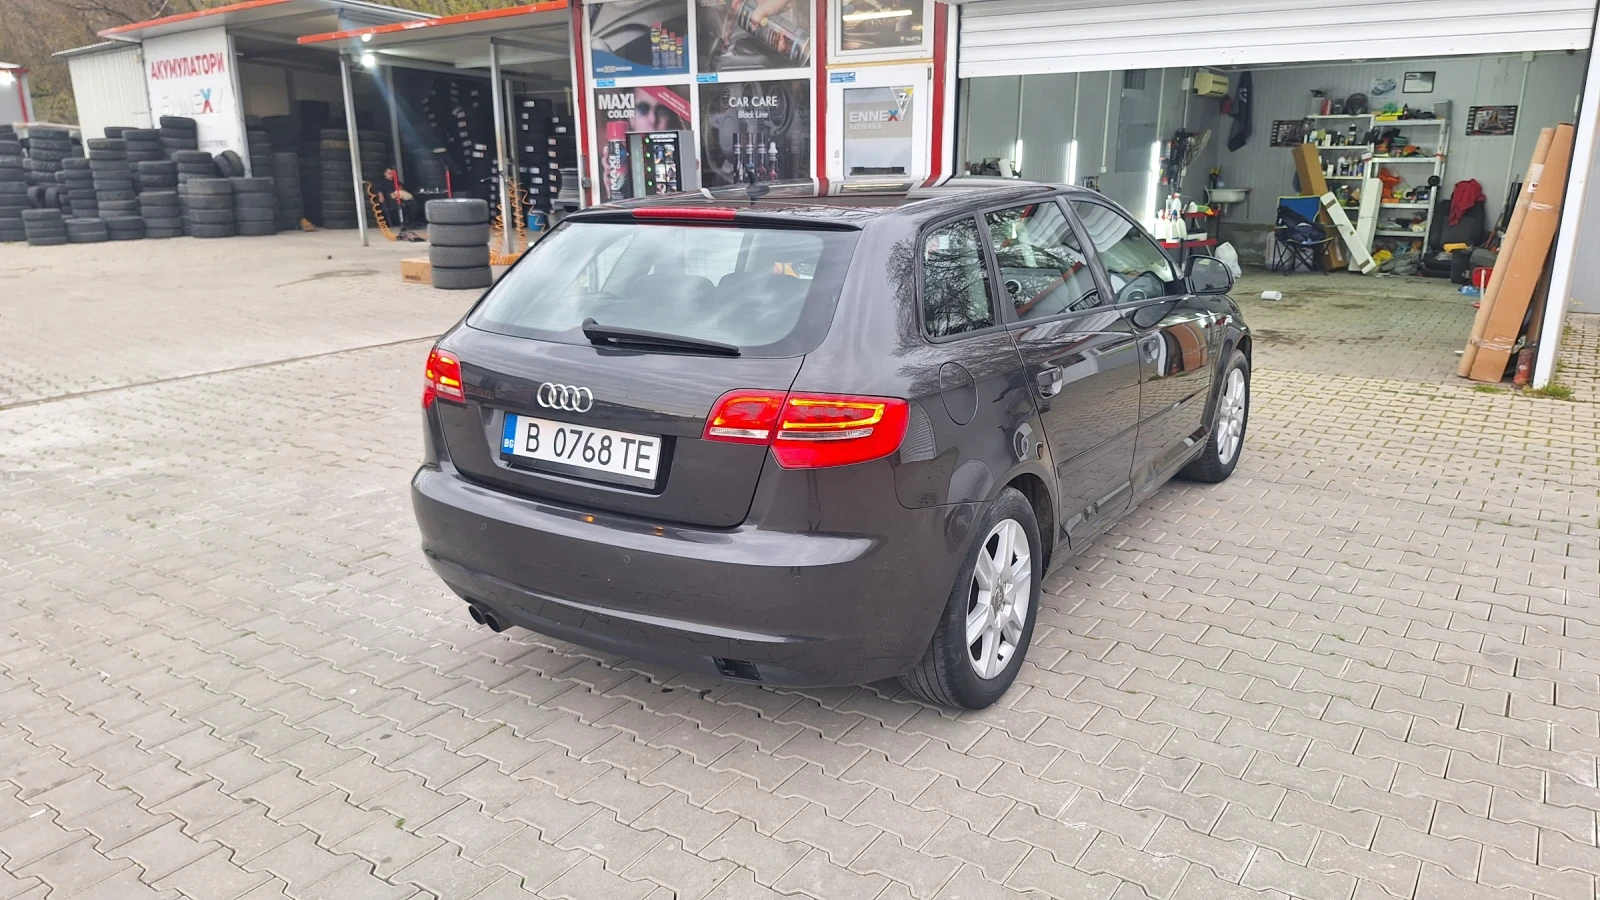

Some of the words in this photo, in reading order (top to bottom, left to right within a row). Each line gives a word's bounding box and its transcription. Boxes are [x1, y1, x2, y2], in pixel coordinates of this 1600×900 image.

[151, 52, 225, 80] АКУМУЛАТОРИ
[598, 93, 635, 110] MAXI
[729, 97, 749, 107] CAR
[752, 96, 778, 107] CARE
[608, 109, 635, 118] COLOR
[738, 110, 755, 118] Black
[755, 110, 769, 118] Line
[609, 155, 618, 190] MAXI
[503, 438, 514, 449] BG
[525, 423, 540, 453] B
[553, 427, 613, 466] 0768
[620, 437, 654, 474] TE
